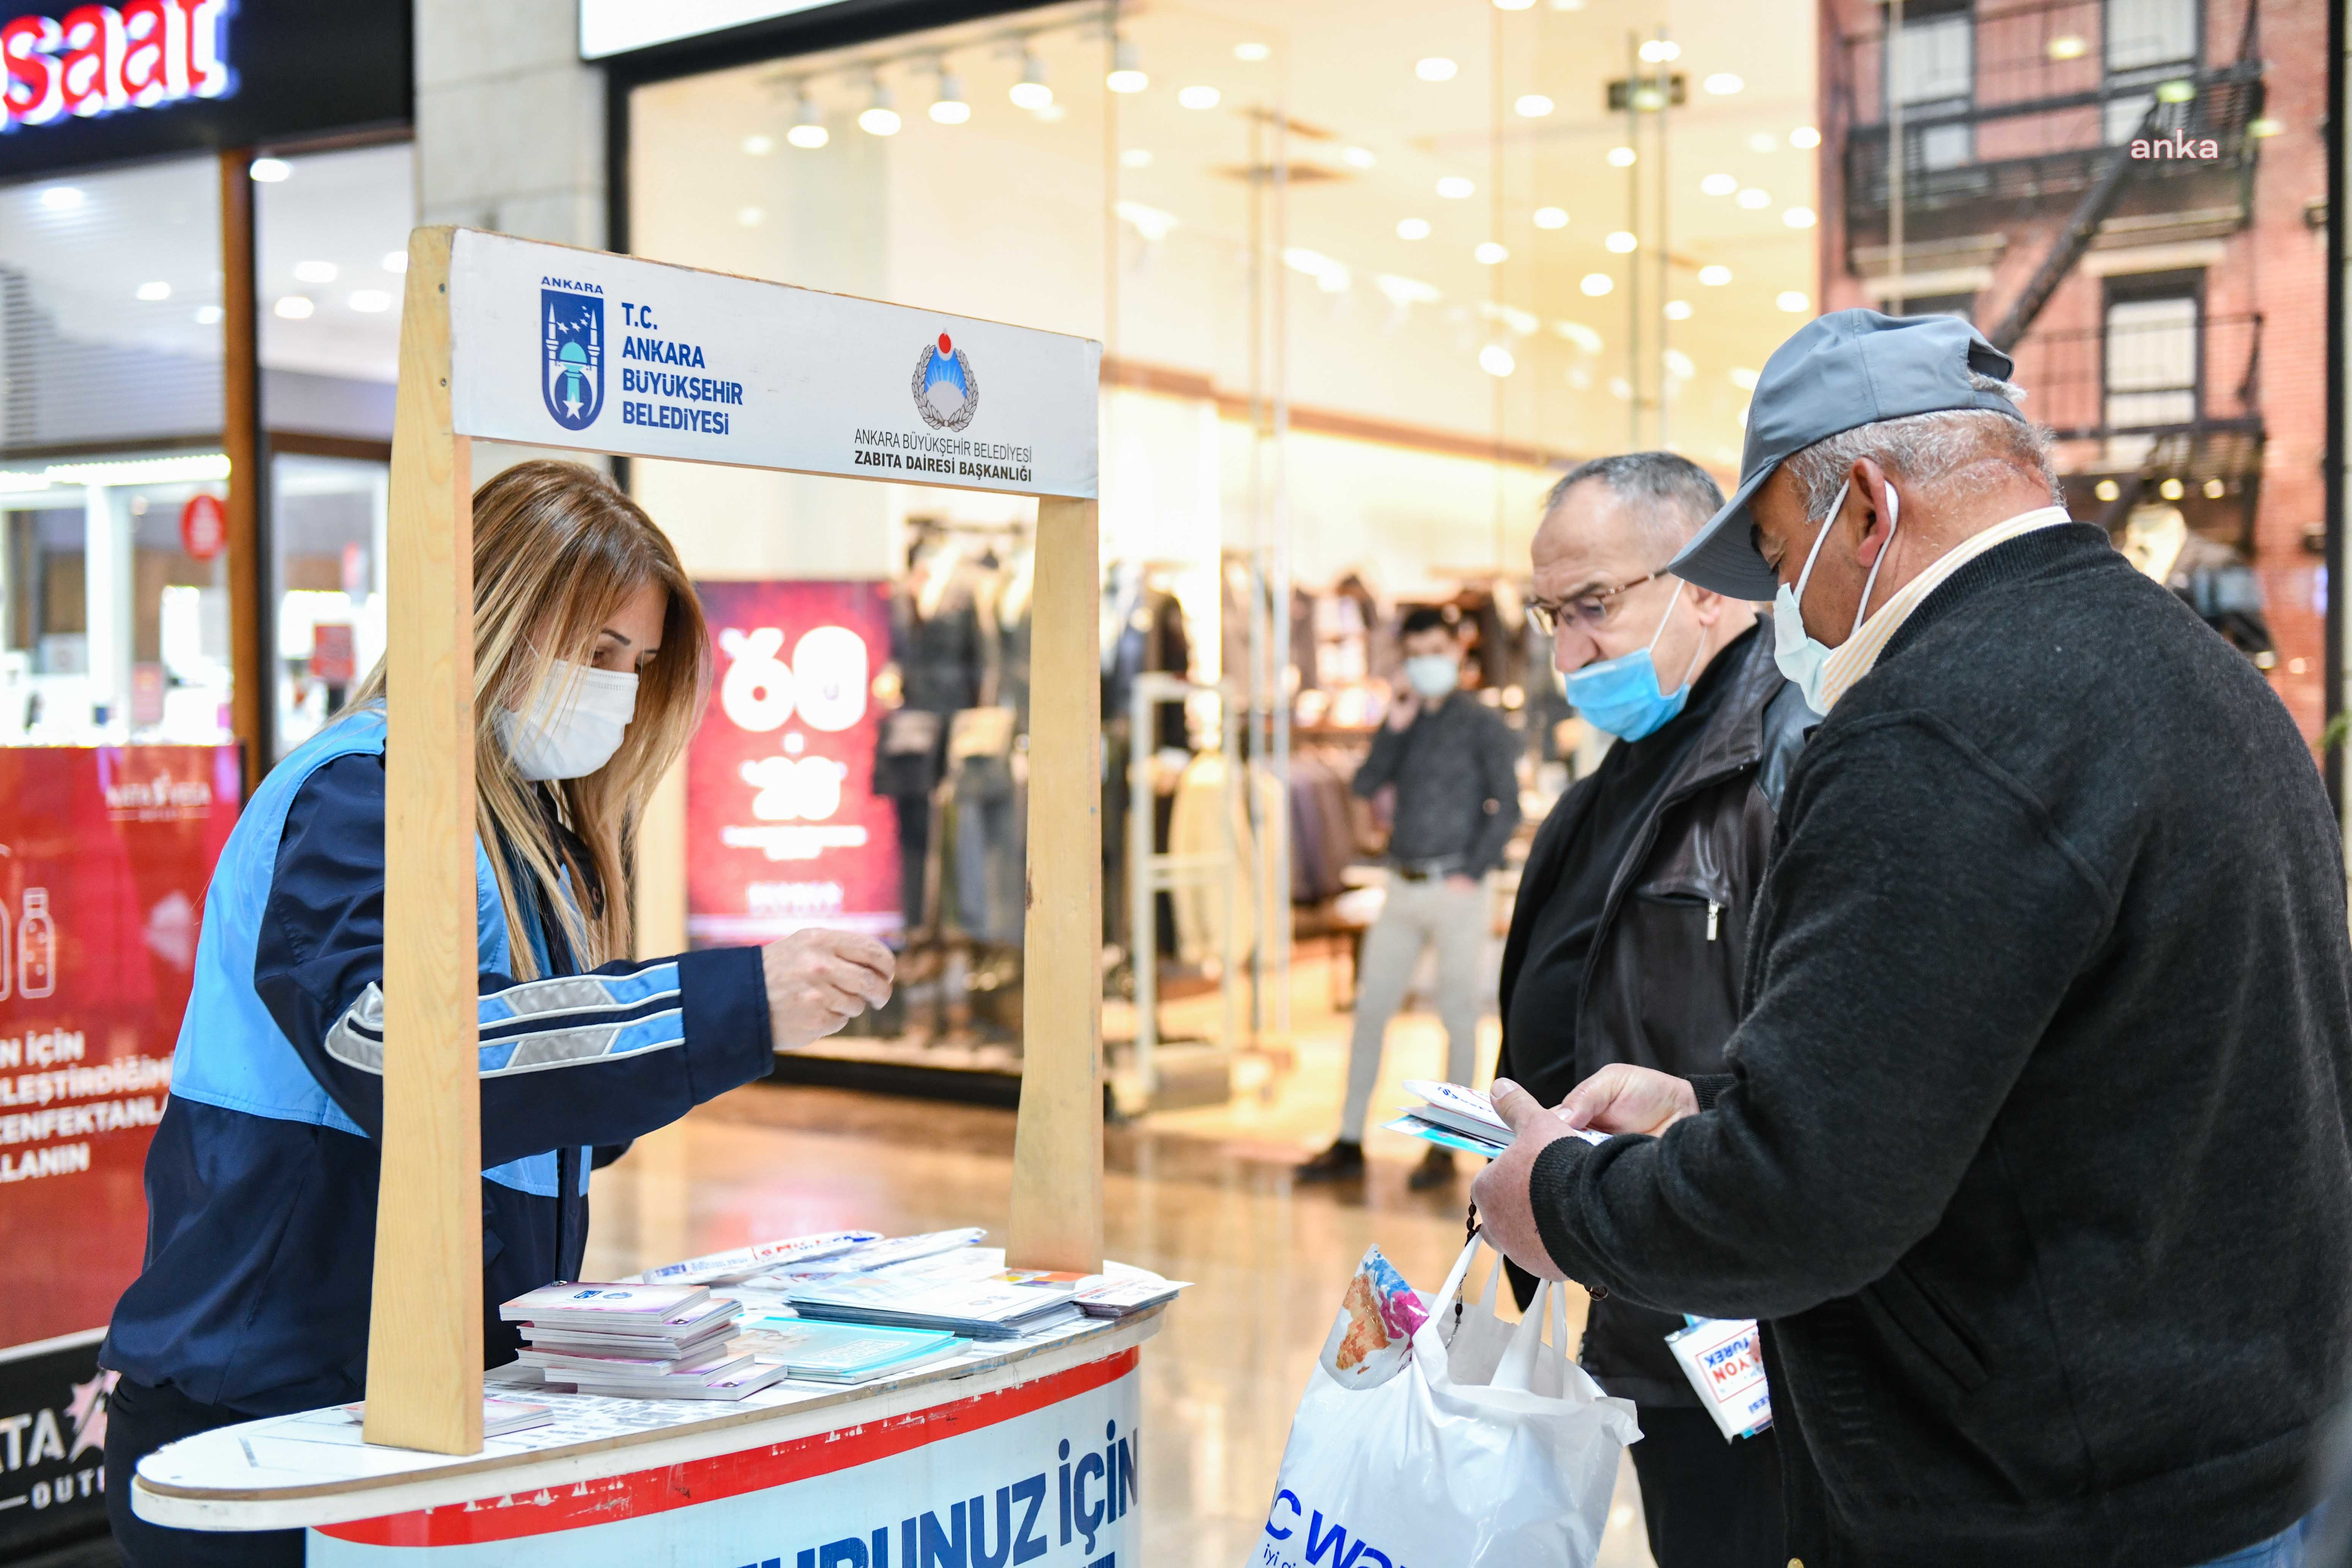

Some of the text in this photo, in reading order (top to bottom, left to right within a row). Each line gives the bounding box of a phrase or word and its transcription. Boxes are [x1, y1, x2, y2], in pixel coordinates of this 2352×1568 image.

[0, 0, 228, 126] saat
[541, 276, 604, 294] ANKARA
[621, 302, 658, 330] T.C.
[622, 336, 705, 369] ANKARA
[623, 368, 743, 405] BÜYÜKŞEHİR
[623, 401, 729, 435] BELEDİYESİ
[855, 428, 1032, 463] ANKARA BÜYÜKŞEHİR BELEDİYESİ
[855, 450, 1031, 482] ZABITA DAİRESİ BAŞKANLIĞI
[26, 1027, 85, 1069] İÇİN
[0, 1092, 169, 1146] ENFEKTANL
[0, 1141, 90, 1184] LANIN
[0, 1407, 66, 1474] TA
[1058, 1419, 1138, 1555] İÇİN
[1265, 1489, 1301, 1540] C
[1263, 1543, 1280, 1566] iyi
